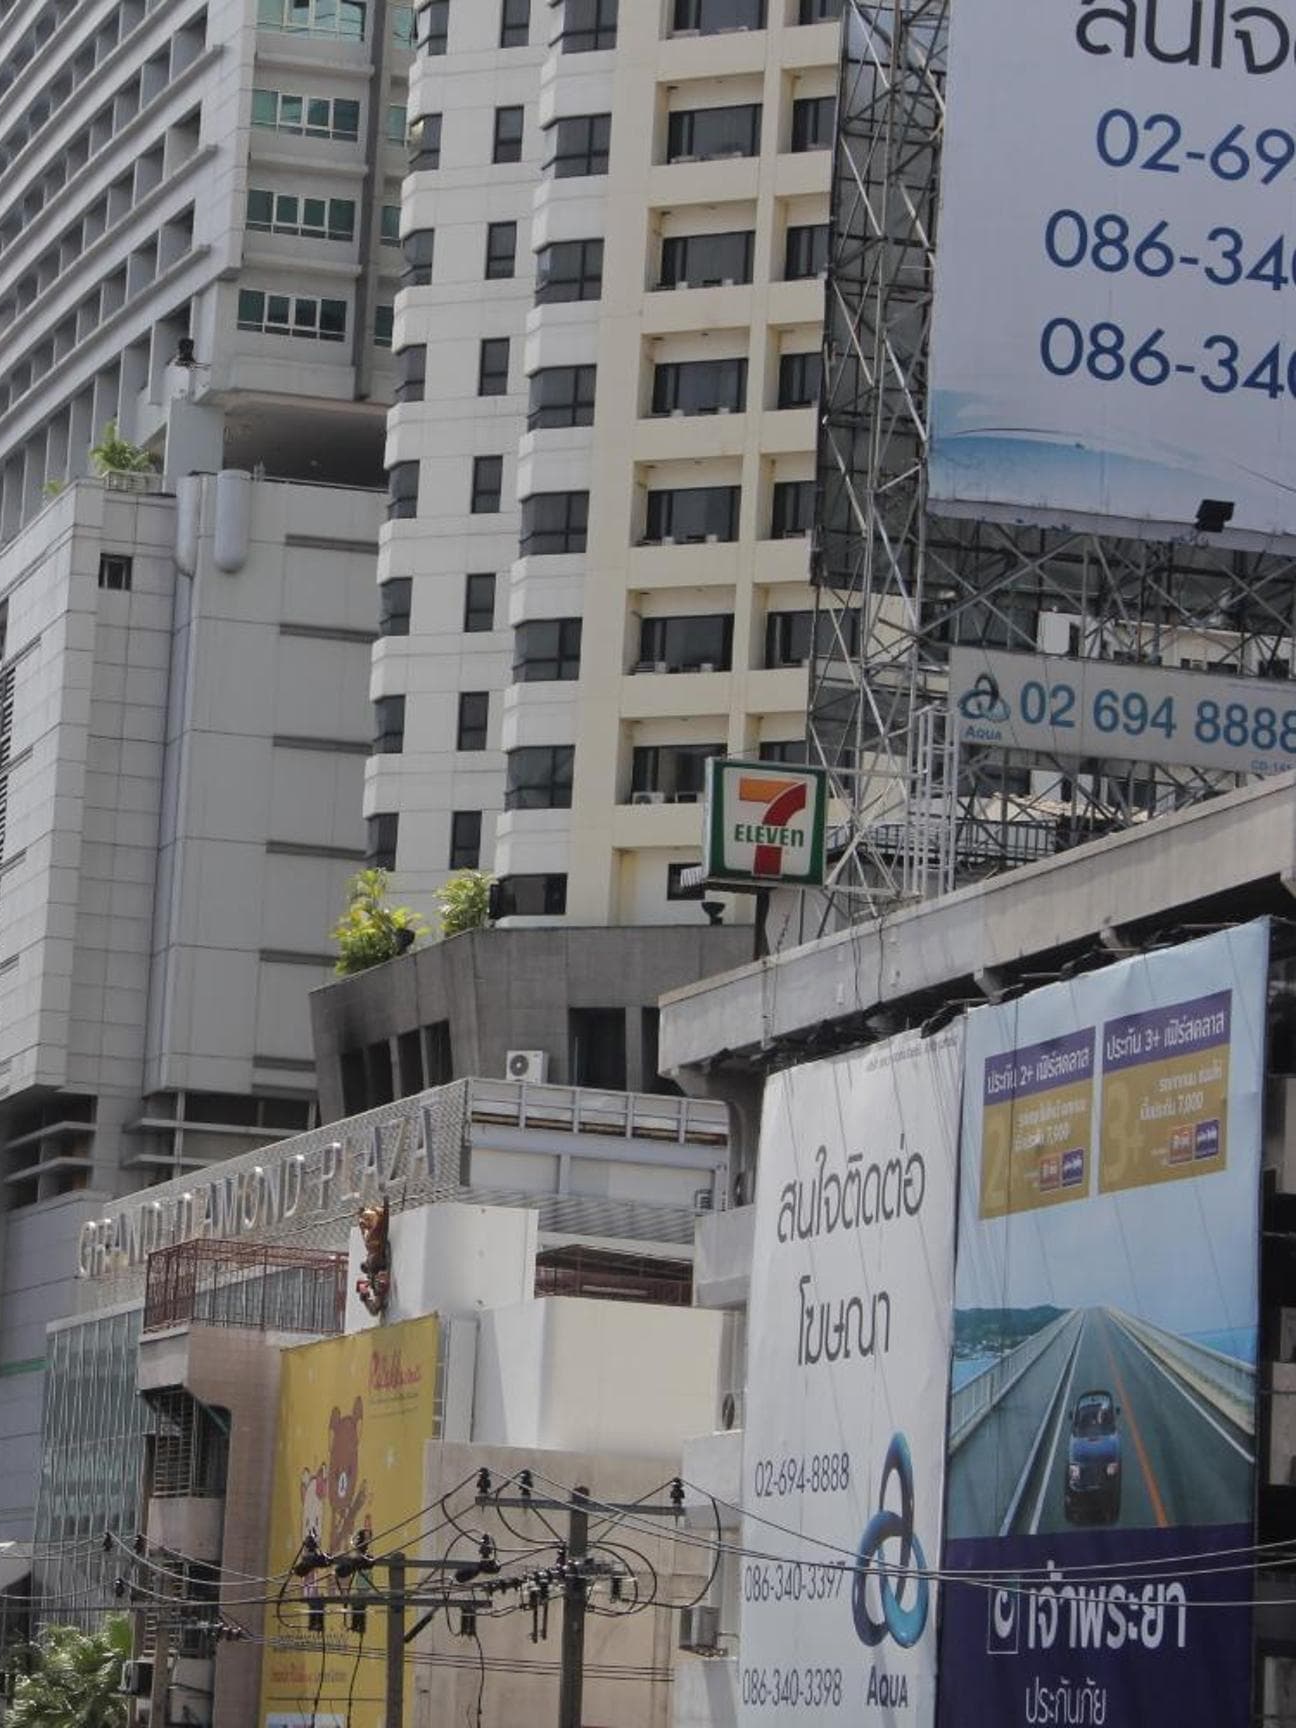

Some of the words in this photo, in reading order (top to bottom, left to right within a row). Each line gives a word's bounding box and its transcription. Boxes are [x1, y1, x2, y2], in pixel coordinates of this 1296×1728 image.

[1044, 209, 1296, 291] 086-34
[1020, 681, 1076, 728] 02
[1093, 689, 1177, 739] 694
[1194, 700, 1296, 754] 8888
[1107, 1029, 1142, 1062] ประกัน
[1145, 1027, 1161, 1053] 3+
[777, 1132, 926, 1244] สนใจติดต่อ
[797, 1274, 891, 1366] โฆษณา
[754, 1452, 851, 1498] 02-694-8888
[744, 1561, 846, 1603] 086-340-3397
[1027, 1559, 1187, 1650] เจ้าพระยา
[742, 1667, 843, 1707] 086-340-3398
[1025, 1676, 1107, 1726] ประกันภัย
